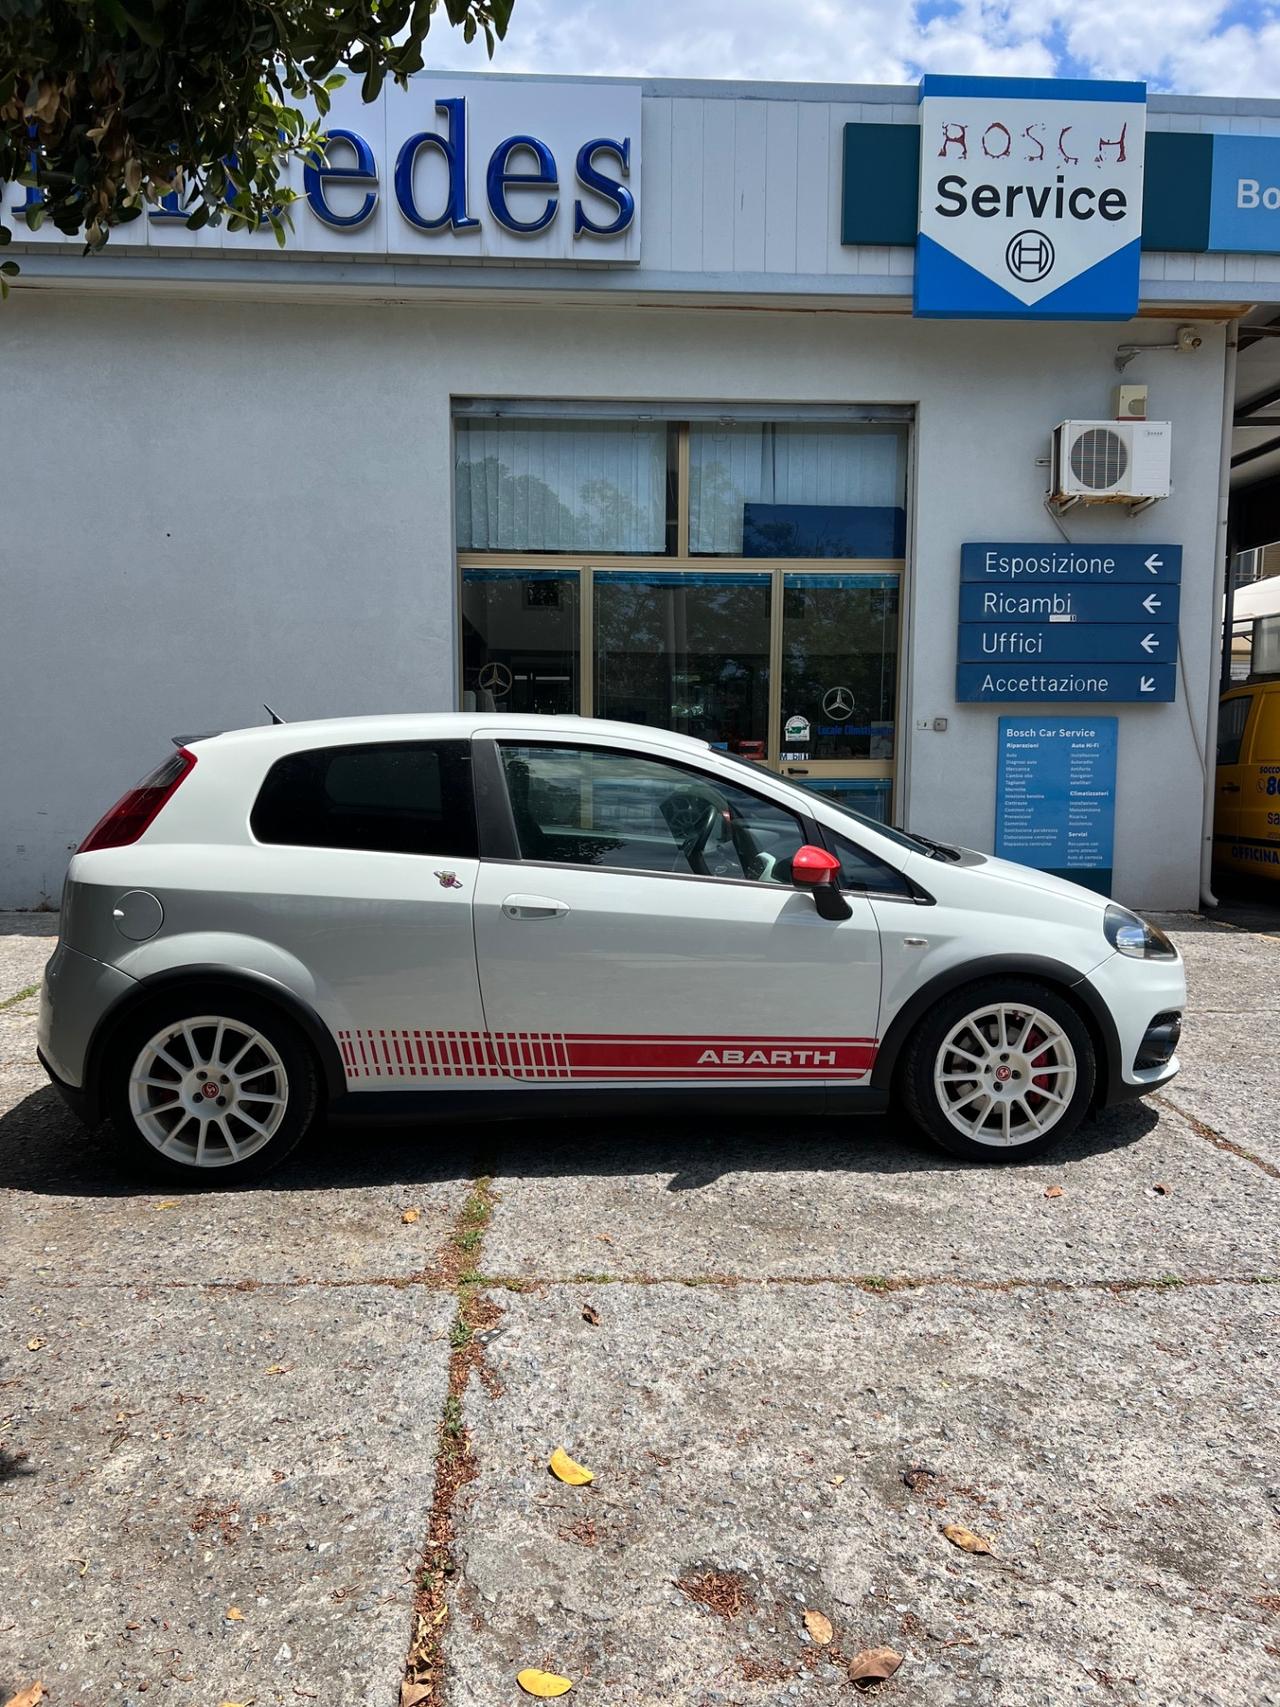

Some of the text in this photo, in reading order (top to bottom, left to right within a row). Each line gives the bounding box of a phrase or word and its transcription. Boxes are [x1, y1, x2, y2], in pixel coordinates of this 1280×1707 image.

[935, 174, 1127, 221] Service
[1236, 178, 1280, 210] Bo
[985, 552, 1115, 578] Esposizione
[983, 592, 1072, 614] Ricambi
[982, 632, 1043, 653] Uffici
[981, 674, 1109, 692] Accettazione
[1006, 729, 1095, 737] Bosch Car Service
[1231, 846, 1280, 865] OFFICINA
[697, 1050, 836, 1065] ABARTH
